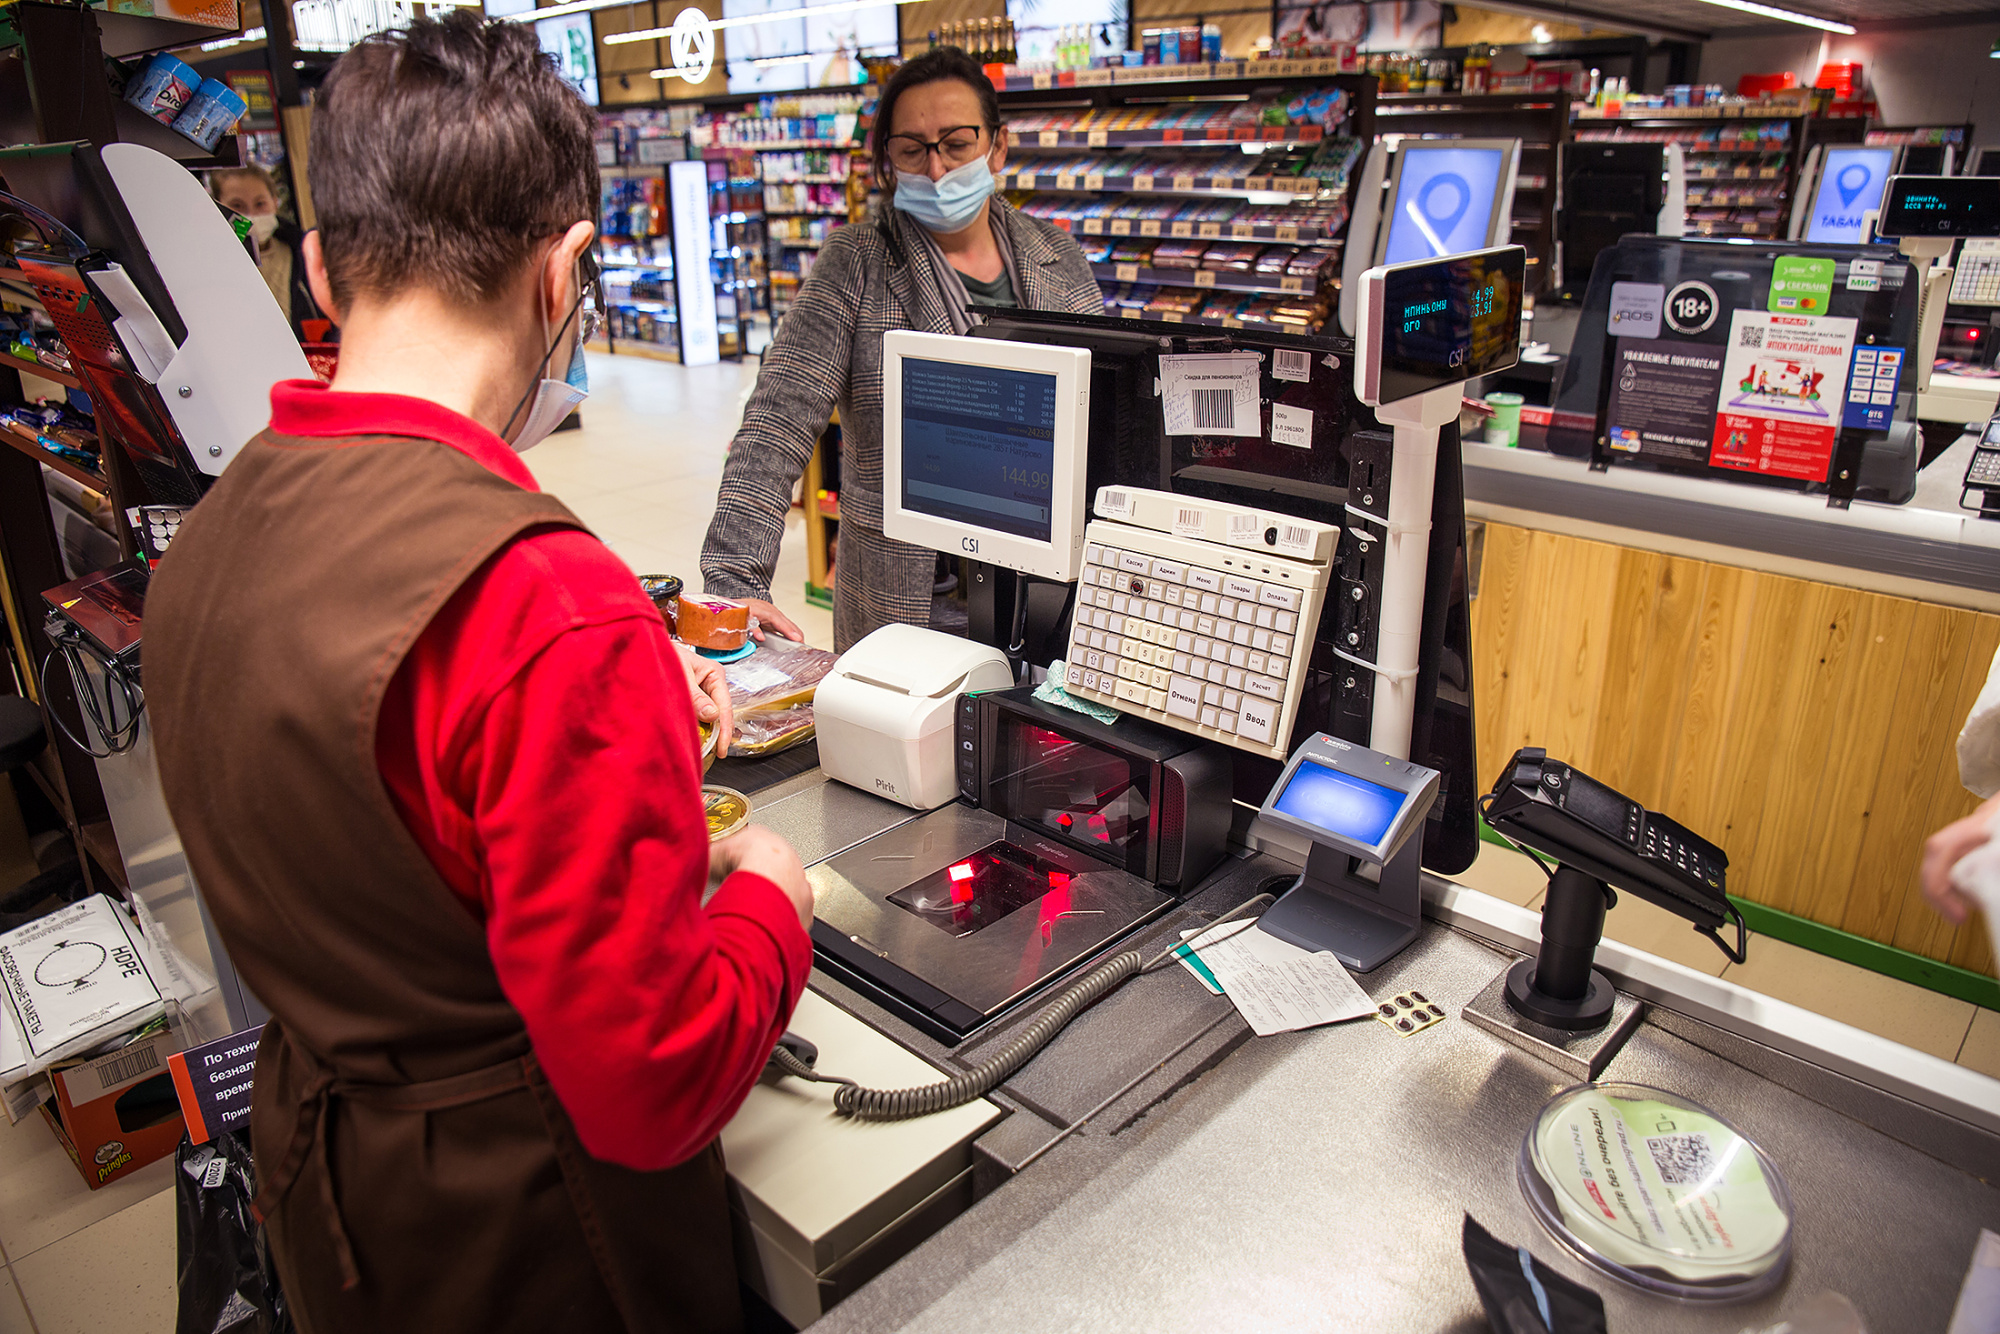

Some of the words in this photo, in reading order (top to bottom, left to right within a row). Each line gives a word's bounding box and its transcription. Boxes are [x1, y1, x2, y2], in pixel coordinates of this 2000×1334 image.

[1786, 281, 1829, 292] СБЕРБАНК
[1674, 297, 1710, 319] 18+
[1766, 340, 1843, 356] #ПОКУПАЙТЕДОМА
[1448, 348, 1464, 369] CSI
[1623, 350, 1671, 366] УВАЖАЕМЫЕ
[1671, 355, 1721, 371] ПОКУПАТЕЛИ
[1868, 409, 1885, 419] ВТБ
[993, 443, 1005, 453] 285
[1001, 465, 1050, 490] 144.99
[1040, 508, 1046, 520] 1
[961, 537, 980, 555] CSI
[1125, 558, 1145, 569] Кассир
[1158, 566, 1176, 576] Админ
[1195, 575, 1213, 585] Меню
[1230, 583, 1252, 594] Товары
[1266, 592, 1289, 603] Оплаты
[1251, 681, 1272, 692] Расчет
[1171, 690, 1197, 705] Отмена
[1245, 712, 1267, 728] Ввод
[875, 777, 896, 794] Pirit
[1034, 840, 1070, 860] Magellan
[111, 945, 142, 979] HDPE
[0, 945, 30, 1002] ФАСОВОЧНЫЕ
[21, 998, 45, 1037] ПАКЕТЫ
[73, 1061, 95, 1075] SOUR
[95, 1052, 123, 1068] CREAM
[124, 1047, 130, 1055] &
[131, 1038, 156, 1053] HERBS
[204, 1053, 223, 1067] По
[215, 1080, 254, 1101] време
[1587, 1107, 1611, 1166] очереди!
[98, 1151, 132, 1183] Pringles
[206, 1160, 222, 1186] 2/2000
[1609, 1171, 1623, 1192] без
[1615, 1119, 1665, 1234] zakaz.spar-kaliningrad.ru
